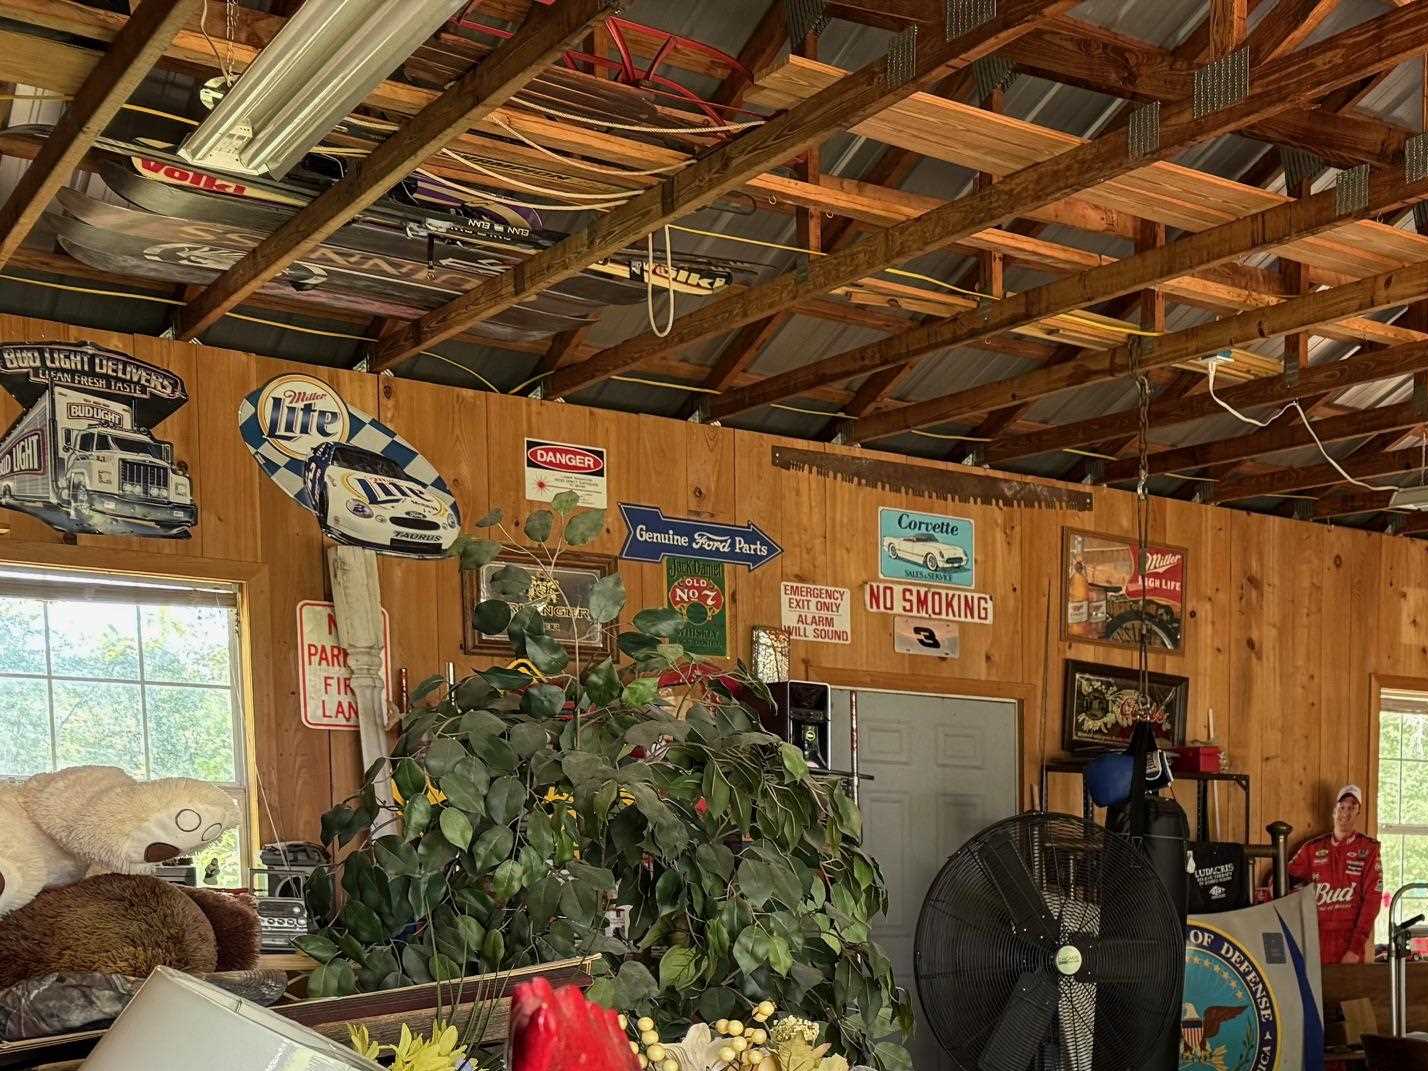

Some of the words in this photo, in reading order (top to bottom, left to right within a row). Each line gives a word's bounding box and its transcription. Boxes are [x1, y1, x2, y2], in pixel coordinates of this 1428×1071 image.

[3, 349, 41, 368] BUD
[45, 348, 91, 371] LIGHT
[95, 357, 174, 394] DELIVERS
[39, 368, 71, 383] CLEAN
[75, 375, 106, 389] FRESH
[110, 380, 142, 393] TASTE
[283, 389, 328, 405] Miller
[70, 405, 93, 418] BUD
[263, 396, 341, 442] Lite
[13, 435, 39, 471] LIGHT
[536, 449, 595, 469] DANGER
[897, 513, 960, 537] Corvette
[393, 530, 442, 542] TAURUS
[636, 524, 689, 547] Genuine
[692, 531, 732, 553] Ford
[734, 536, 768, 556] Parts
[1145, 553, 1182, 571] Miller
[685, 578, 708, 588] OLD
[904, 569, 924, 580] SALES
[927, 571, 953, 583] SERVICE
[1162, 578, 1182, 592] LIFE
[702, 590, 718, 606] 7
[783, 584, 846, 601] EMERGENCY
[868, 584, 895, 611] NO
[902, 588, 990, 621] SMOKING
[788, 598, 811, 611] EXIT
[815, 600, 841, 613] ONLY
[796, 614, 835, 628] ALARM
[783, 625, 808, 639] WILL
[812, 628, 850, 642] SOUND
[912, 626, 942, 649] 3
[306, 643, 350, 669] PARK
[324, 676, 353, 696] FIR
[321, 700, 359, 722] LAN
[1194, 862, 1235, 879] LUDACRIS
[1315, 882, 1358, 905] Bud
[1189, 929, 1214, 947] OF
[1221, 942, 1273, 1022] DEFENSE
